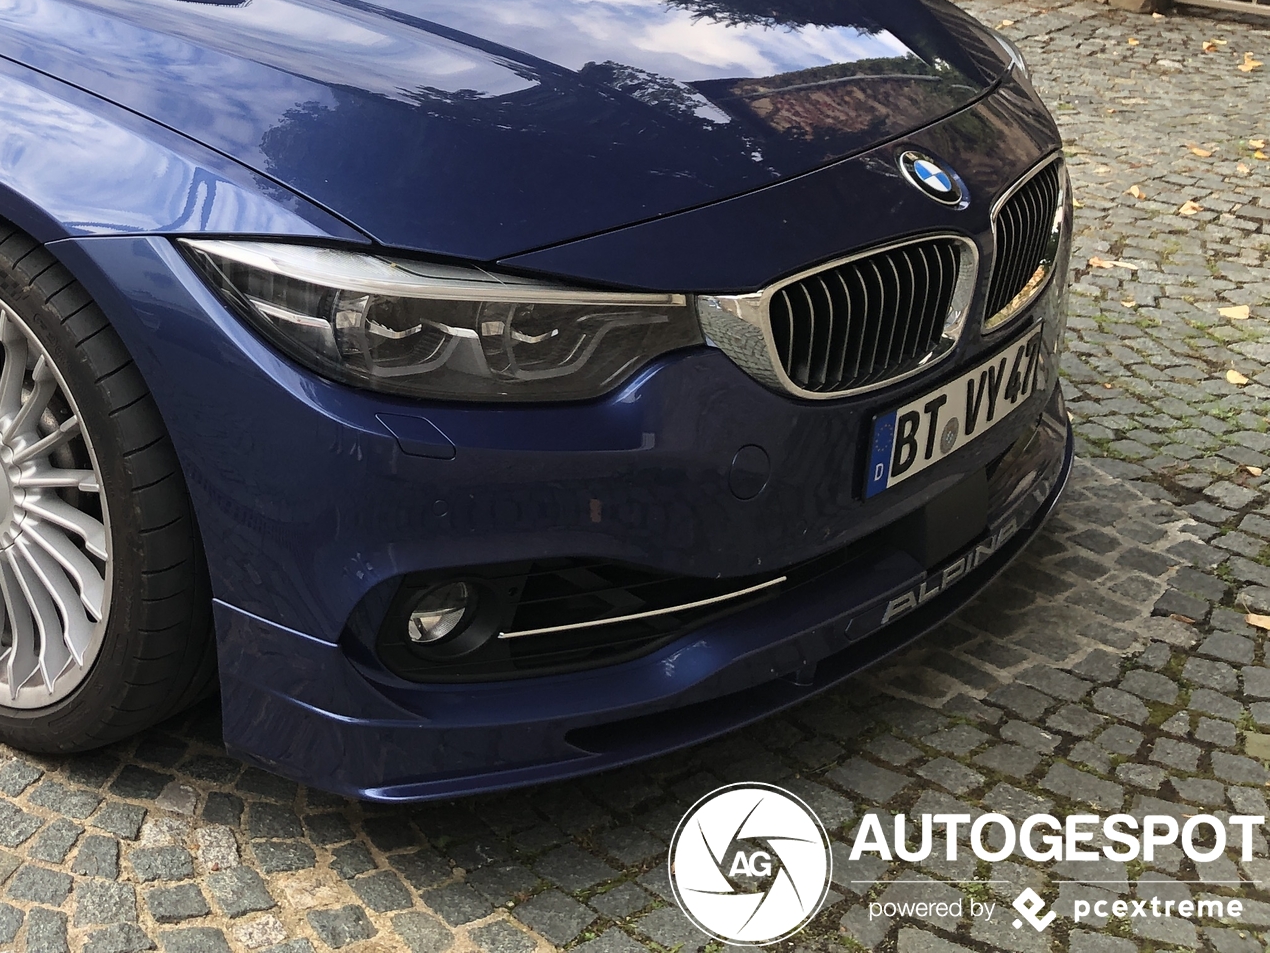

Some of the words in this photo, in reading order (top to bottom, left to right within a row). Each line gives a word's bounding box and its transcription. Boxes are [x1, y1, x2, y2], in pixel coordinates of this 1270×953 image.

[891, 393, 949, 478] BT
[965, 357, 1007, 436] VY
[1004, 331, 1041, 404] 47
[873, 462, 884, 482] D
[880, 516, 1019, 625] ALPINA
